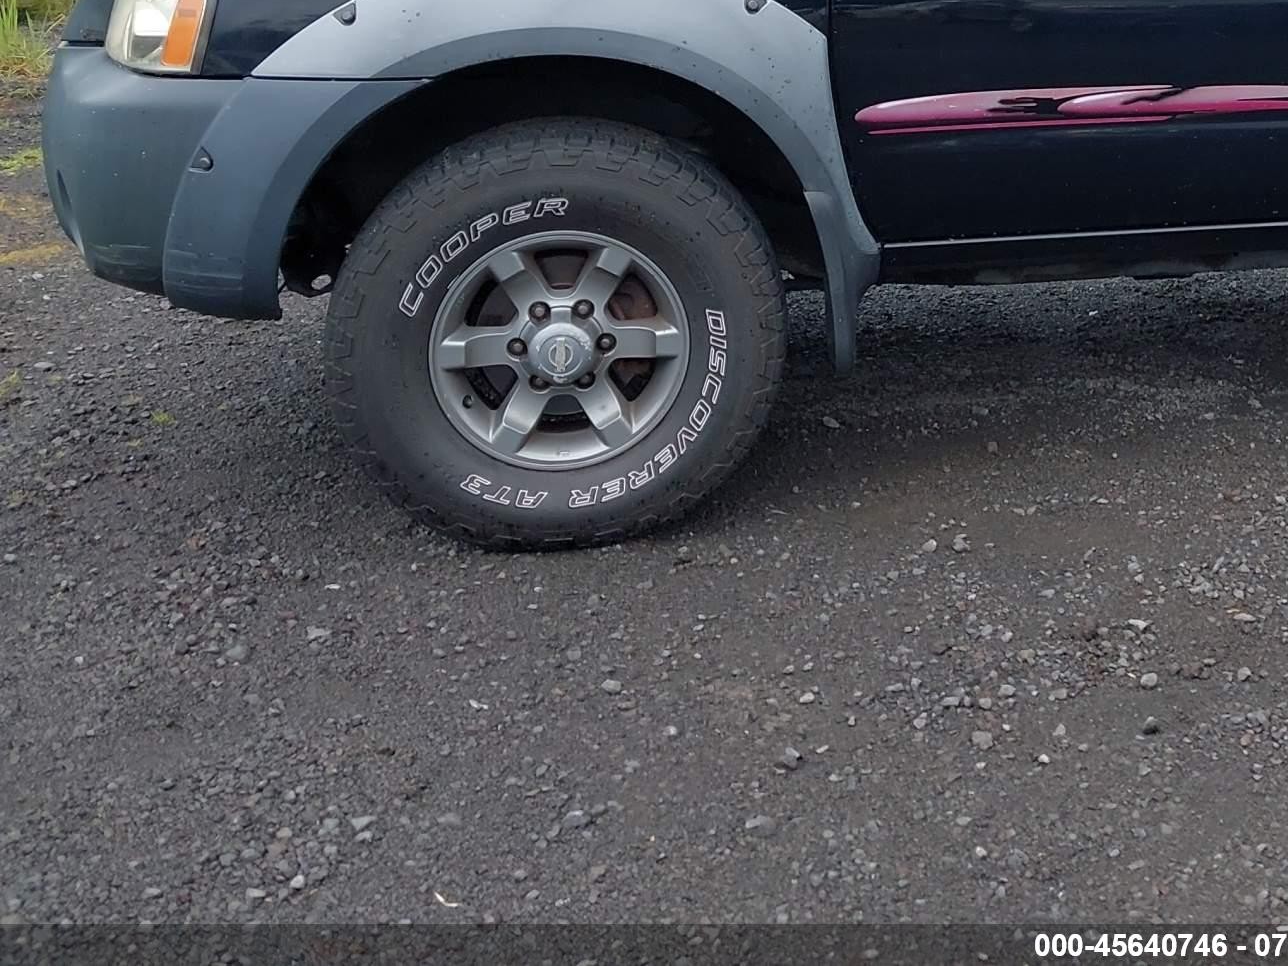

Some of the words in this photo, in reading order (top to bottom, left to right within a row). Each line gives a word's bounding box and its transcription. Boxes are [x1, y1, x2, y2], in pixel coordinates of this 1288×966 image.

[398, 197, 569, 318] COOPER
[568, 308, 728, 509] DISCOVERER
[460, 473, 548, 509] AT3
